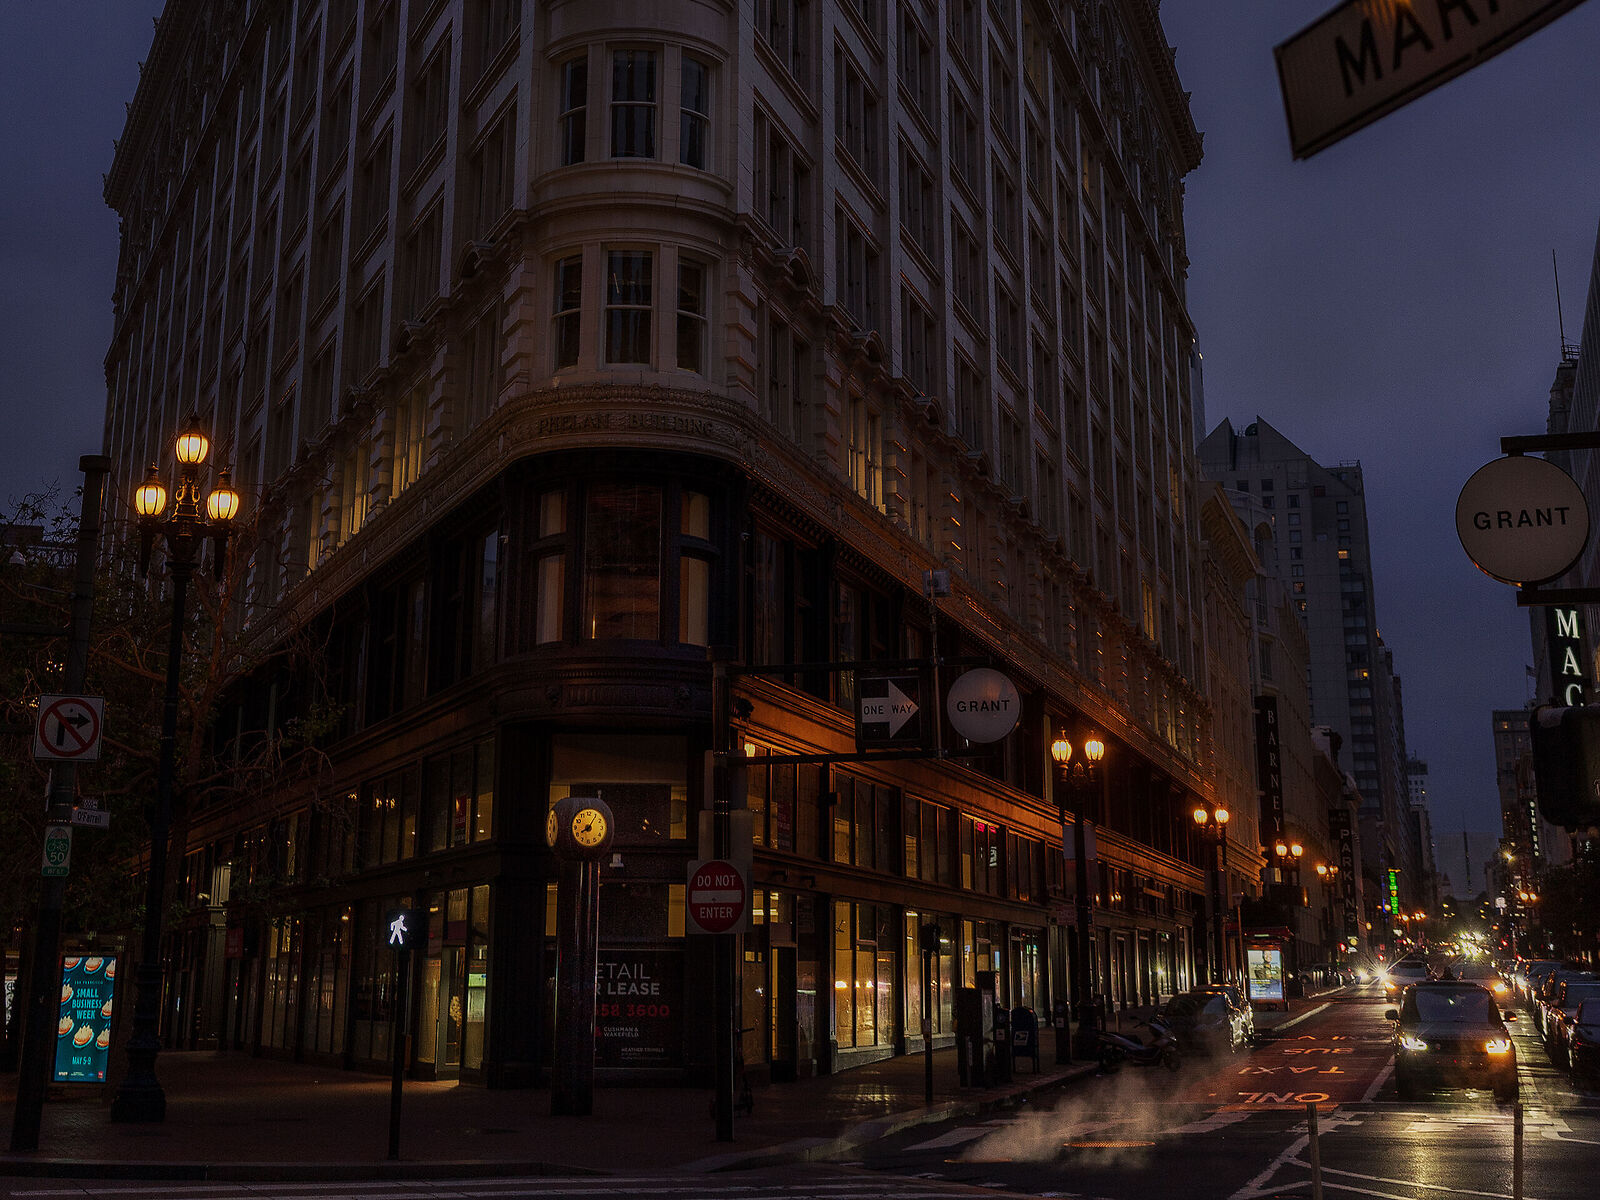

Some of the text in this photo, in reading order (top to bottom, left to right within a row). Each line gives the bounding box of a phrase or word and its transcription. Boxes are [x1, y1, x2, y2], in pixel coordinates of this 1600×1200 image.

[538, 413, 714, 436] PHELAN BUILDING
[1473, 506, 1570, 530] GRANT
[863, 704, 913, 715] ONE WAY
[956, 699, 1010, 713] GRANT
[50, 852, 65, 862] 50
[697, 874, 737, 887] DO NOT
[1340, 828, 1356, 922] PARKING
[700, 906, 734, 919] ENTER
[76, 988, 99, 998] SMALL
[608, 983, 660, 995] LEASE
[72, 999, 102, 1009] BUSINESS
[76, 1009, 96, 1020] WEEK
[1238, 1066, 1345, 1075] TAXI
